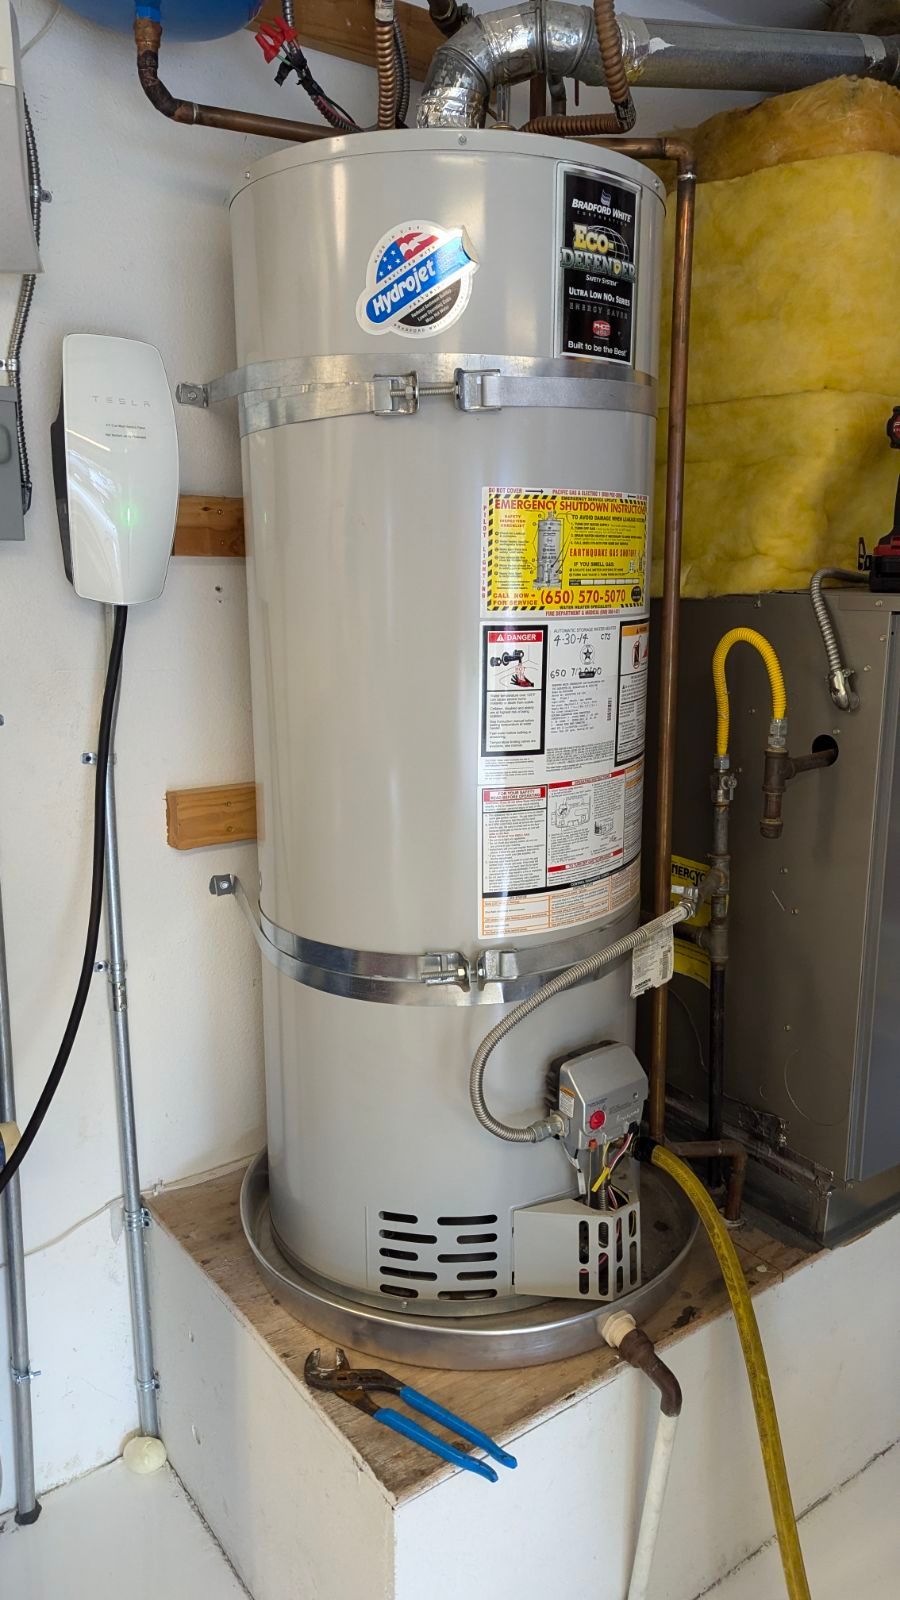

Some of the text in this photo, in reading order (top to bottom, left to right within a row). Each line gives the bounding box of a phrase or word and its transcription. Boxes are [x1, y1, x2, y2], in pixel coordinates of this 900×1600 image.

[572, 198, 632, 222] BRADFORD WHITE
[560, 247, 635, 278] DEFENDER
[372, 259, 436, 316] Hydrojet
[569, 286, 588, 297] ULTRA
[589, 290, 602, 299] LOW
[616, 296, 630, 307] SERIES
[568, 340, 584, 349] Built
[593, 344, 602, 352] be
[603, 345, 613, 354] the
[92, 395, 151, 407] TESLA
[494, 499, 558, 510] EMERGENCY
[559, 501, 609, 512] SHUTDOWN
[569, 547, 608, 557] EARTHQUAKE
[541, 590, 574, 605] (650)
[578, 589, 626, 604] 570-5070
[506, 633, 537, 641] DANGER
[553, 633, 589, 647] 4-30-14
[550, 669, 567, 679] 650
